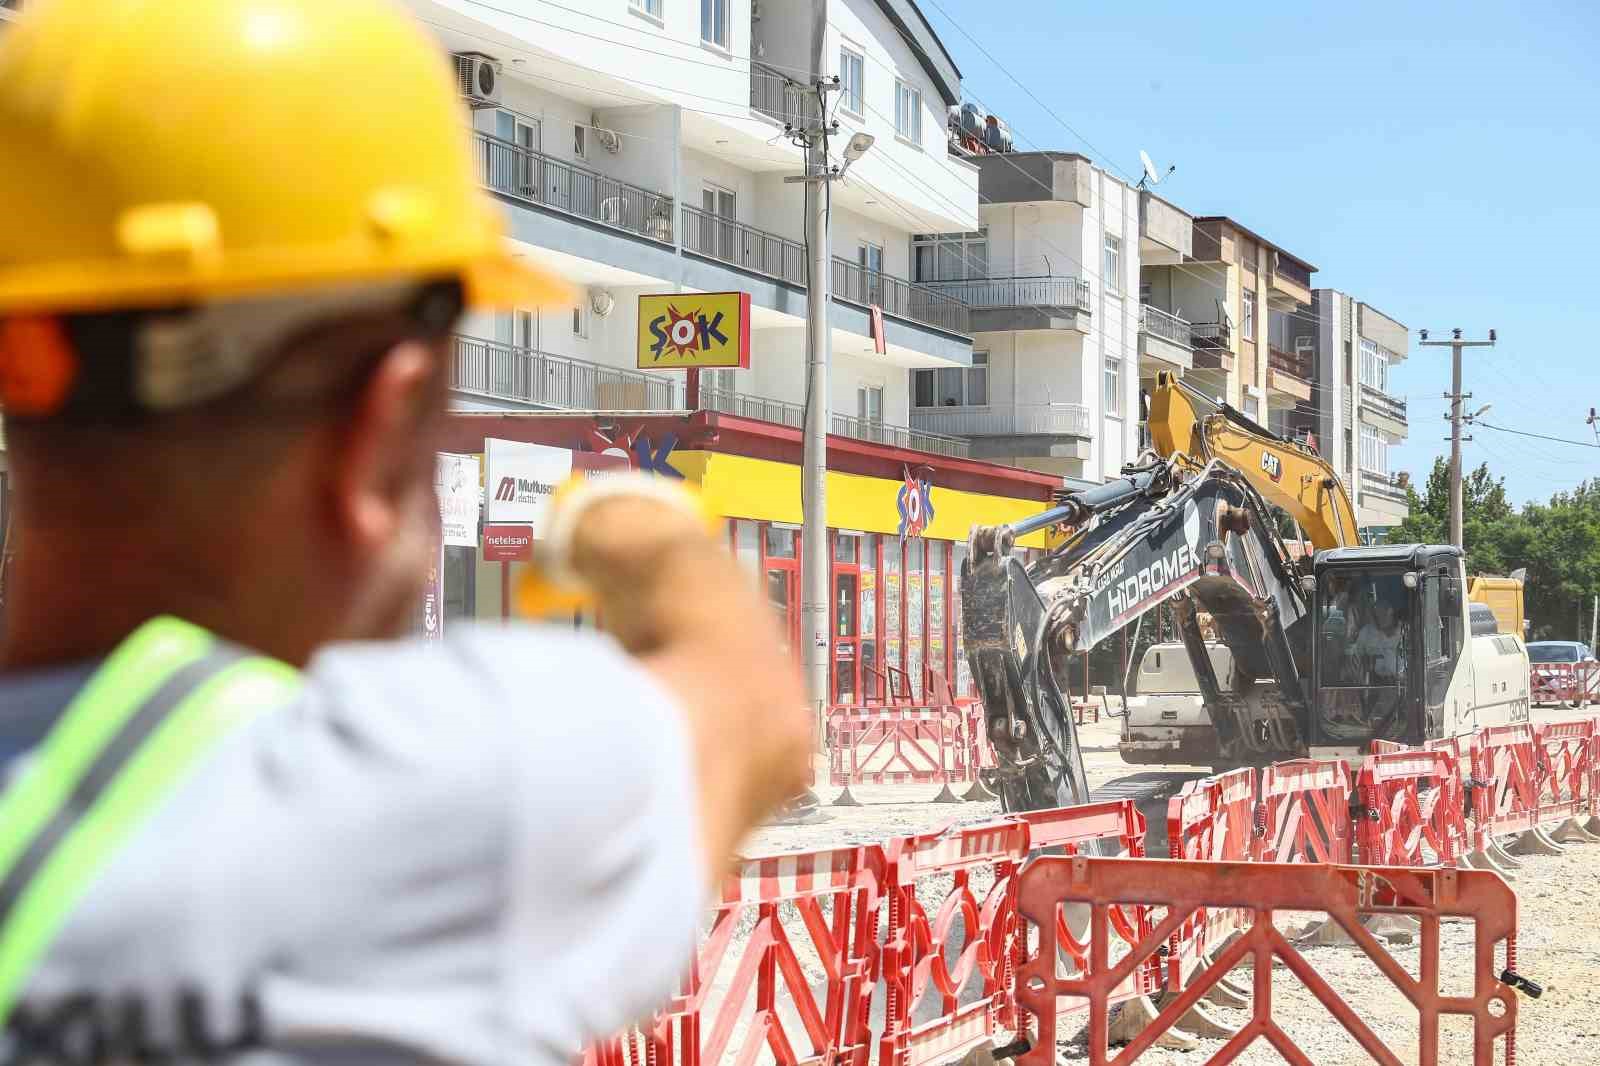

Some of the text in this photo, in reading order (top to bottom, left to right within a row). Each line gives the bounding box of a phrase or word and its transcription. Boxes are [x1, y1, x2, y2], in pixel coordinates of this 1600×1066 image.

[650, 310, 729, 361] ŞOK
[1262, 450, 1279, 477] CAT
[488, 536, 528, 545] netelsan
[1107, 544, 1201, 620] HİDROMEK
